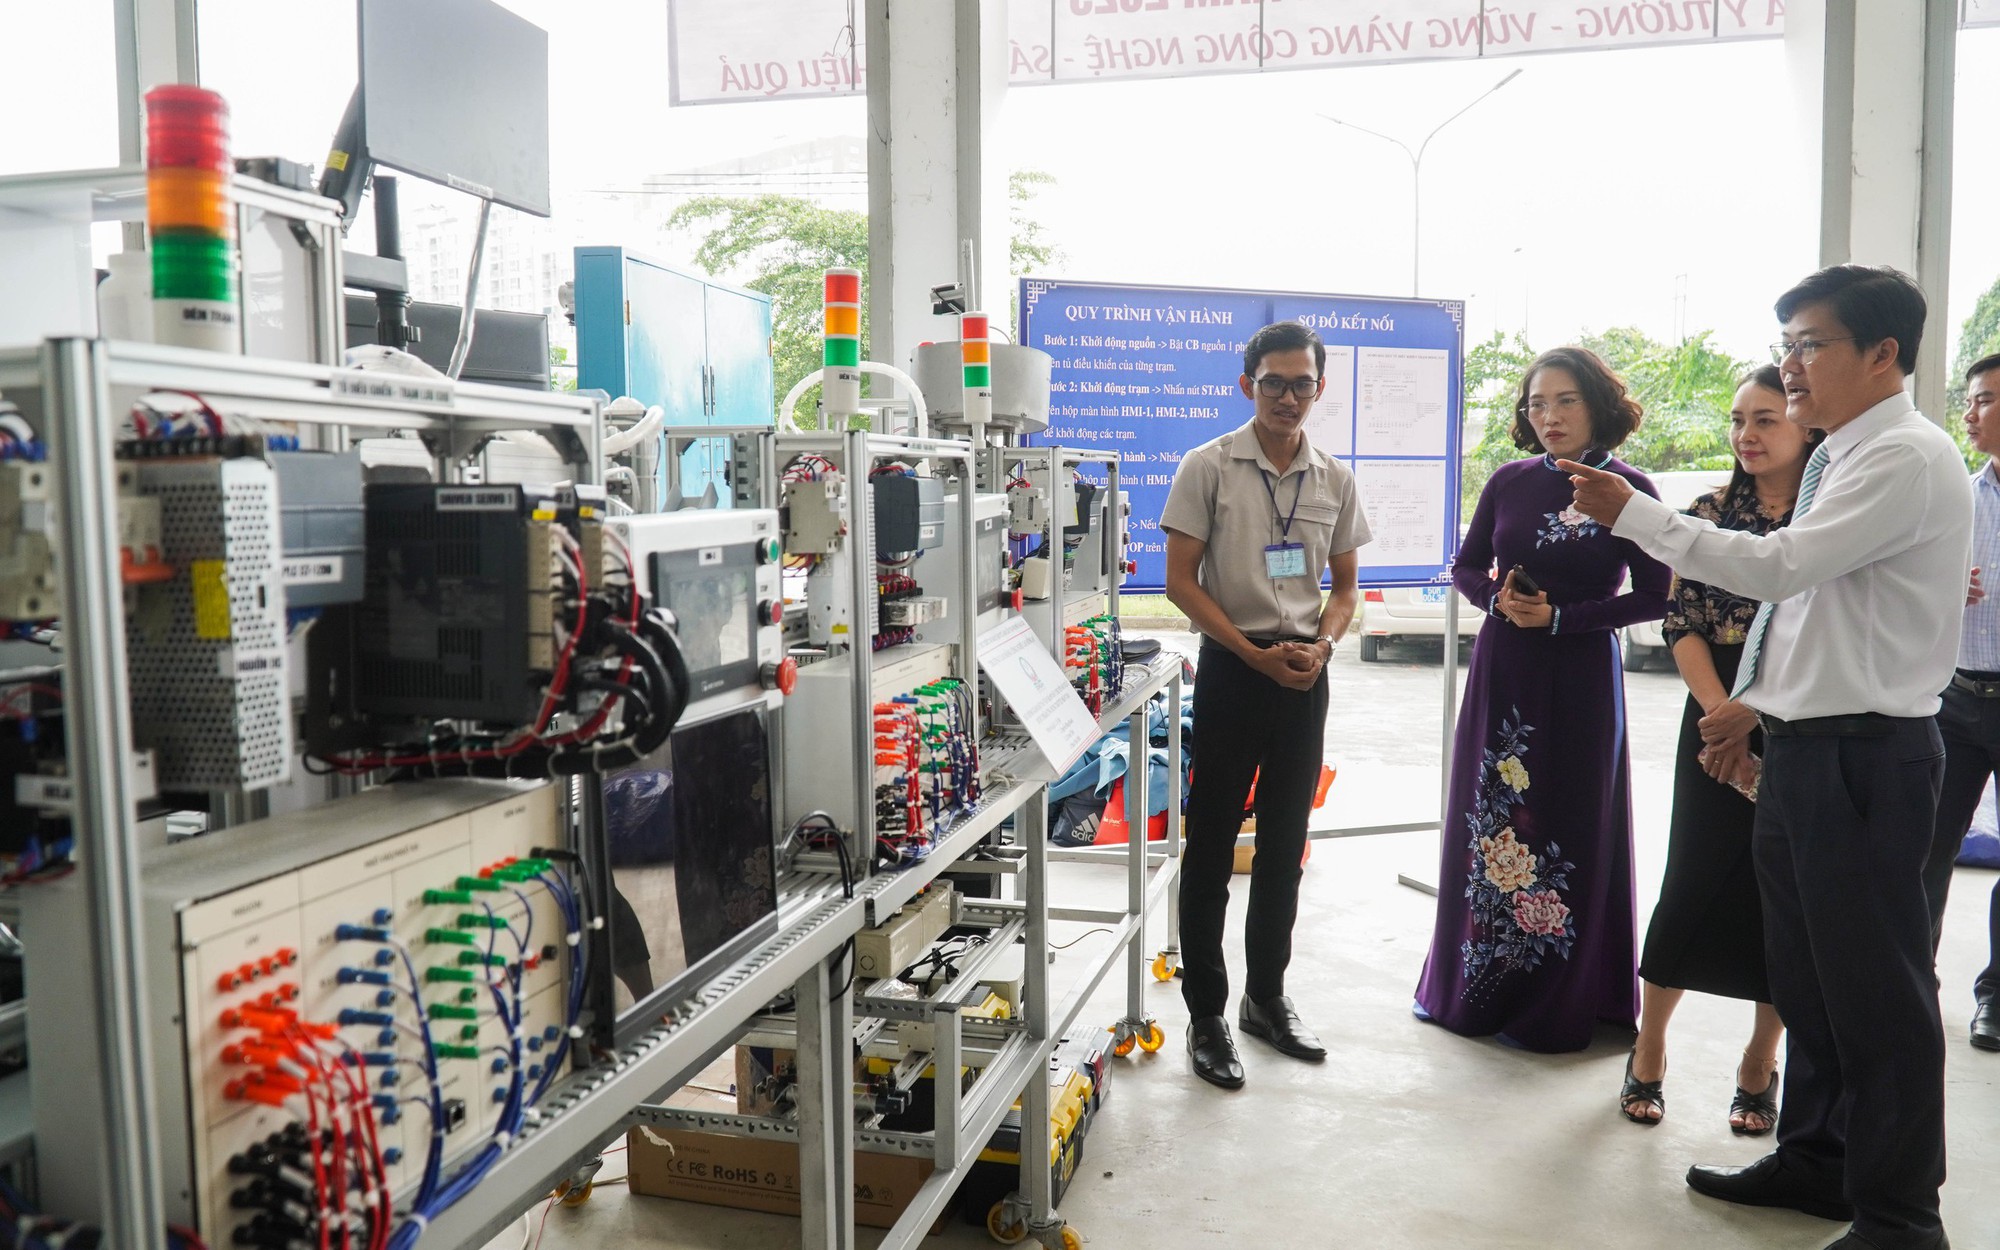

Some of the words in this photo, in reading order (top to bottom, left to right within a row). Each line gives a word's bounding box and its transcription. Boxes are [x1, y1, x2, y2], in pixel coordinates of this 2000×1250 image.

[1065, 304, 1099, 322] QUY
[1103, 304, 1151, 322] TRÌNH
[1155, 306, 1186, 325] VẬN
[1190, 307, 1233, 324] HÀNH
[1318, 310, 1338, 329] ĐỒ
[1341, 312, 1368, 330] KẾT
[1371, 314, 1394, 331] NỐI
[1044, 334, 1067, 346] Bước
[1070, 335, 1078, 346] 1:
[1081, 335, 1102, 347] Khởi
[1105, 336, 1126, 350] động
[1129, 335, 1155, 351] nguồn
[1169, 339, 1183, 350] Bật
[1185, 339, 1199, 349] CB
[1202, 339, 1226, 353] nguồn
[1050, 357, 1060, 368] ên
[1074, 356, 1092, 369] điều
[1094, 357, 1117, 370] khiển
[1119, 358, 1133, 371] của
[1051, 381, 1067, 393] ước
[1069, 382, 1077, 393] 2:
[1081, 382, 1102, 393] Khởi
[1104, 383, 1126, 396] động
[1128, 385, 1149, 396] trạm
[1163, 383, 1185, 395] Nhấn
[1187, 385, 1200, 395] nút
[1202, 385, 1234, 396] START
[1081, 406, 1098, 417] màn
[1101, 405, 1119, 417] hình
[1121, 406, 1154, 418] HMI-1,
[1156, 406, 1188, 419] HMI-2,
[1190, 407, 1219, 419] HMI-3
[1056, 427, 1074, 439] khởi
[1077, 428, 1097, 441] động
[1100, 428, 1114, 439] các
[1124, 451, 1146, 462] hành
[1071, 829, 1096, 842] adid
[713, 1164, 758, 1184] RoHS
